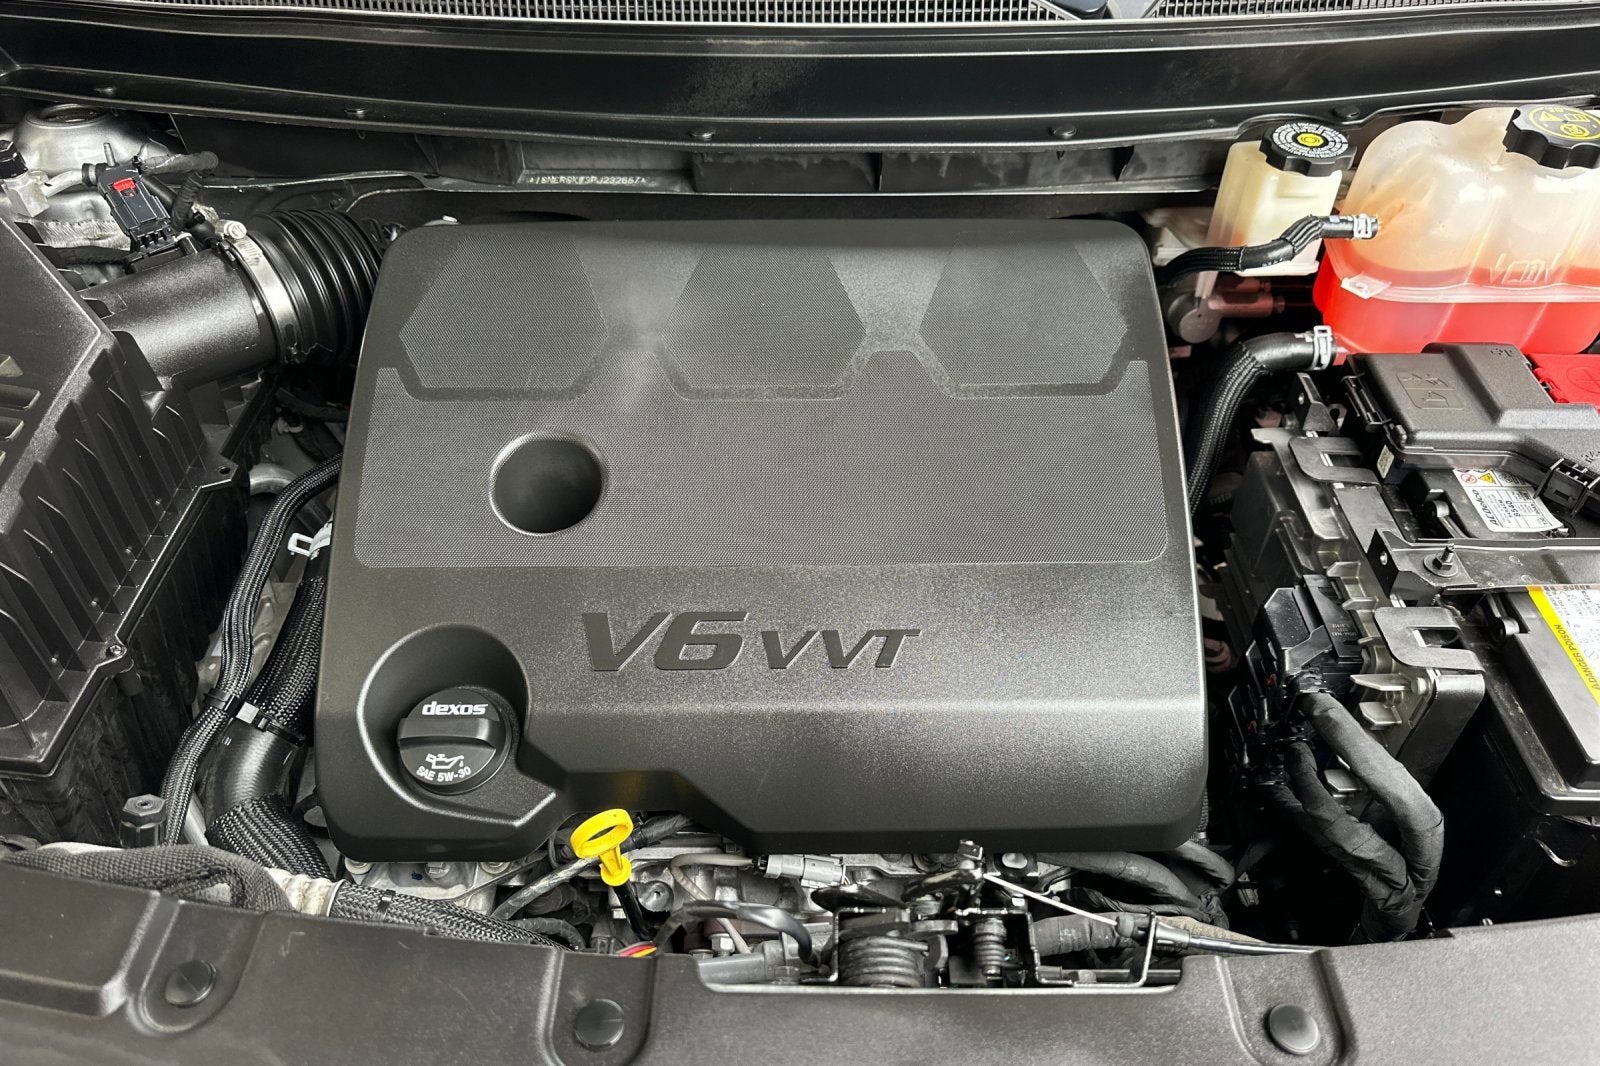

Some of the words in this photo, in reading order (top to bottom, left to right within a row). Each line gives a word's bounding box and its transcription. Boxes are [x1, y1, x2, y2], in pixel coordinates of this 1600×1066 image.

[582, 611, 749, 672] V6
[760, 629, 922, 670] VVT
[1554, 624, 1577, 651] POISON
[421, 700, 489, 716] dexos
[416, 765, 436, 781] SAE
[437, 765, 472, 782] 5W-30
